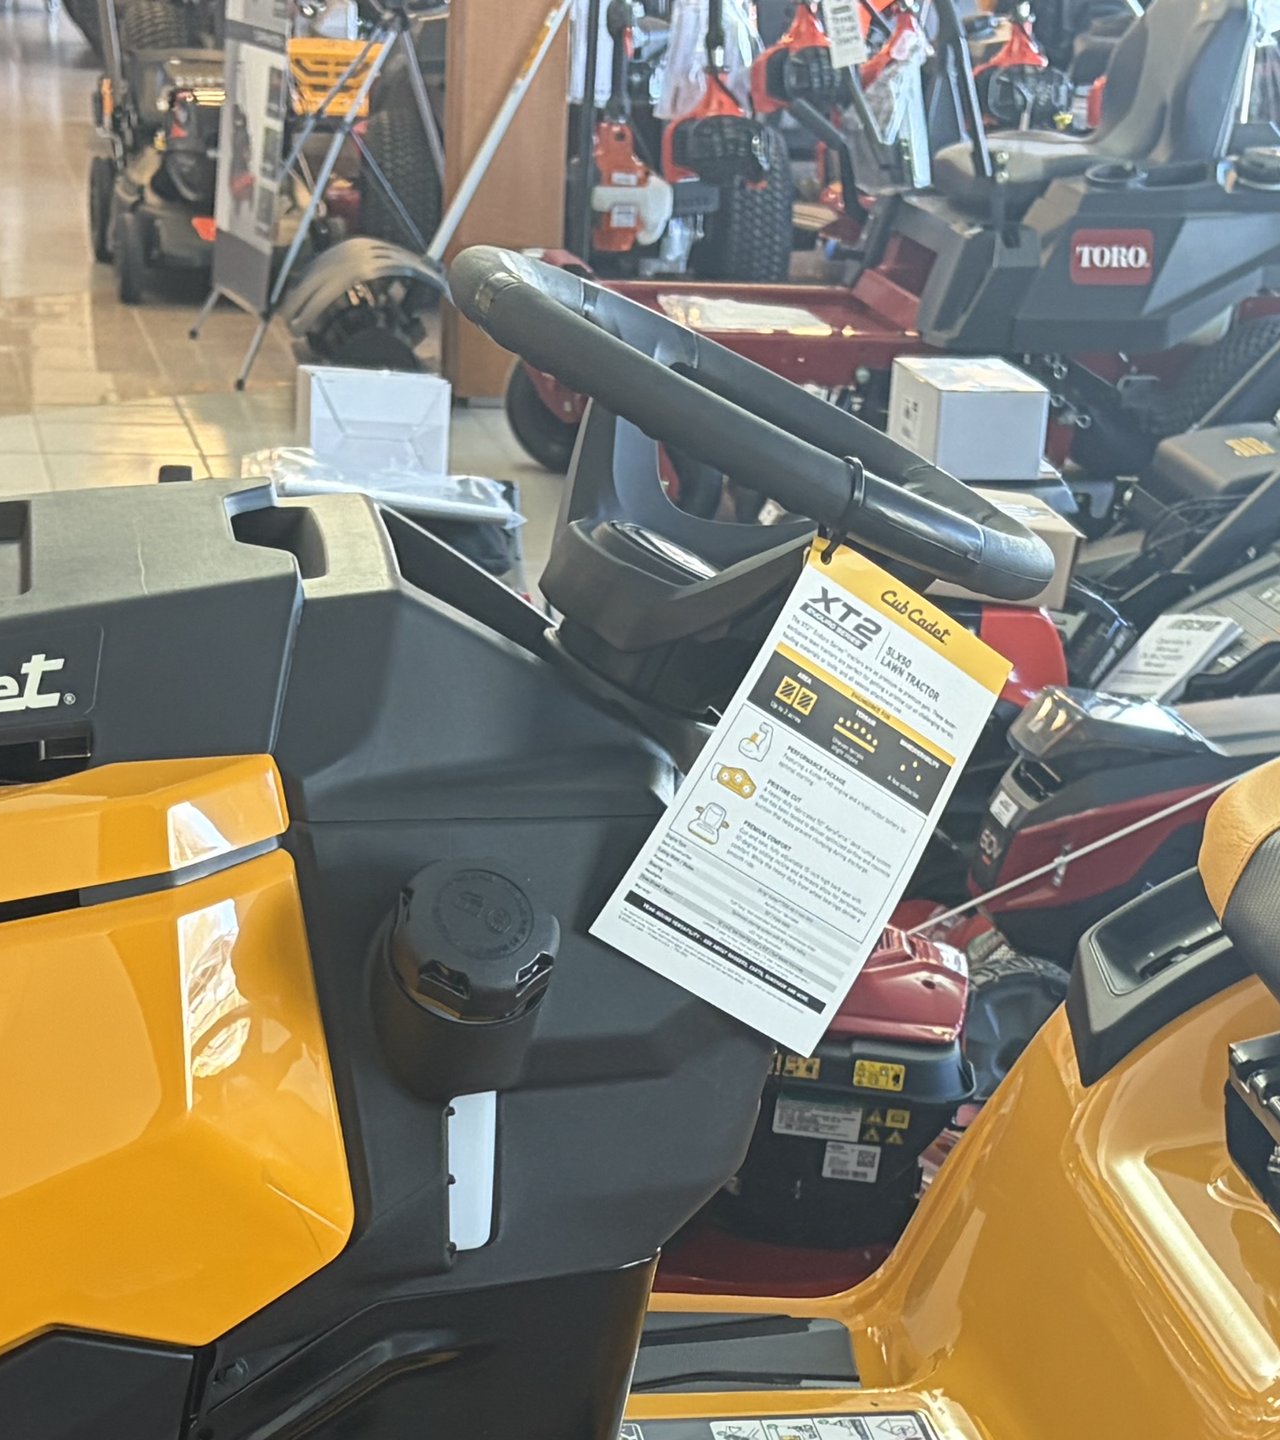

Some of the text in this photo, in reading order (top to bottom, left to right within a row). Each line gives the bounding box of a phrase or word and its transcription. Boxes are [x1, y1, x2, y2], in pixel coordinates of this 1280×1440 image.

[1076, 245, 1148, 268] TORO
[810, 586, 882, 642] XT2
[879, 586, 952, 644] Cub Cadet
[879, 655, 941, 701] LAWN TRACTOR
